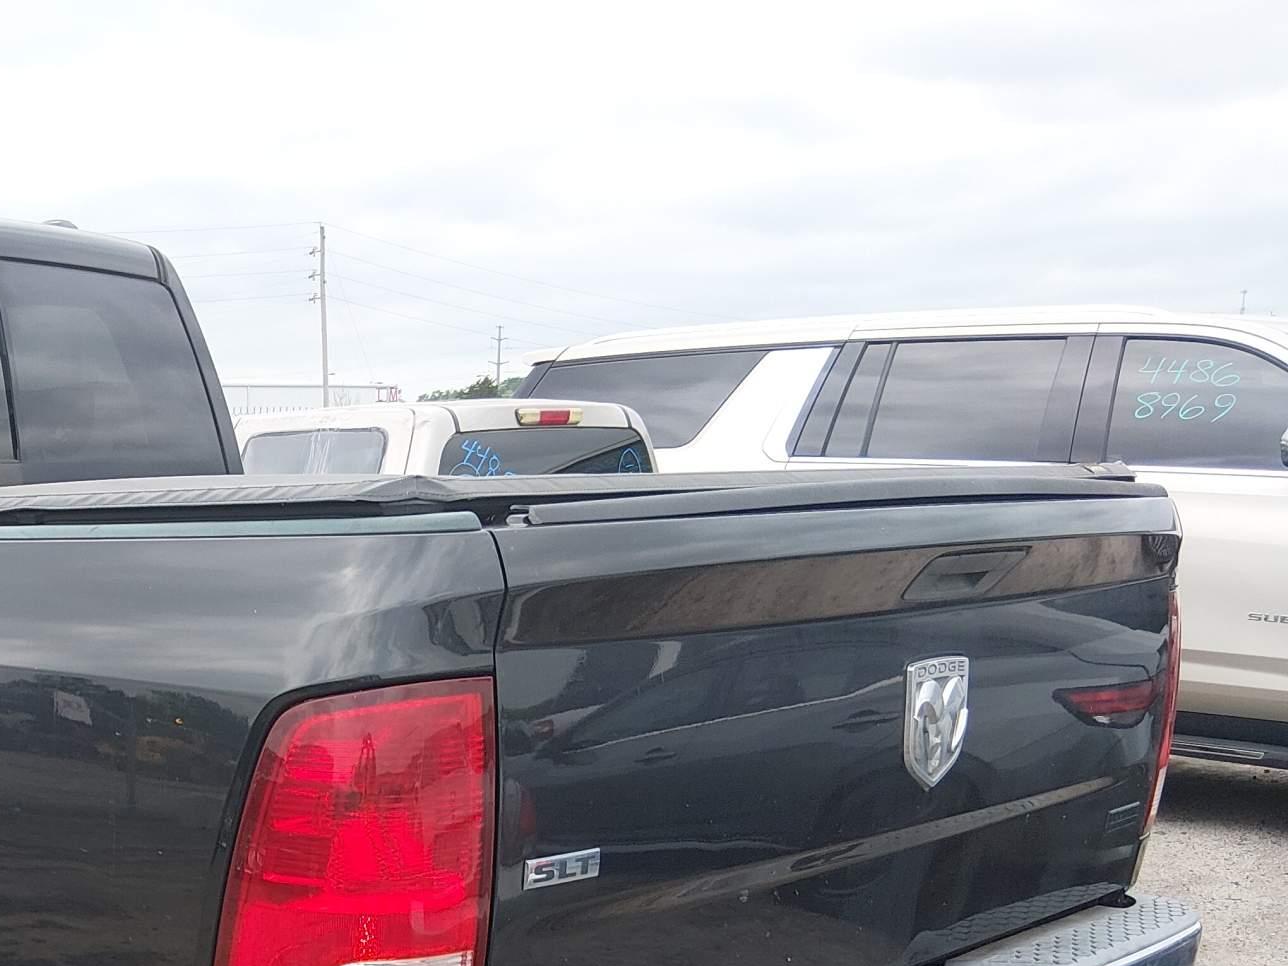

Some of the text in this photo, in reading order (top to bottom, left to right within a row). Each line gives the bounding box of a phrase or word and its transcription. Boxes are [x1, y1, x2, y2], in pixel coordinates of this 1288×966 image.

[1138, 357, 1240, 387] 4486
[1134, 392, 1236, 423] 8969
[462, 440, 516, 476] 448
[917, 660, 966, 678] DODGE
[532, 851, 600, 883] SLT
